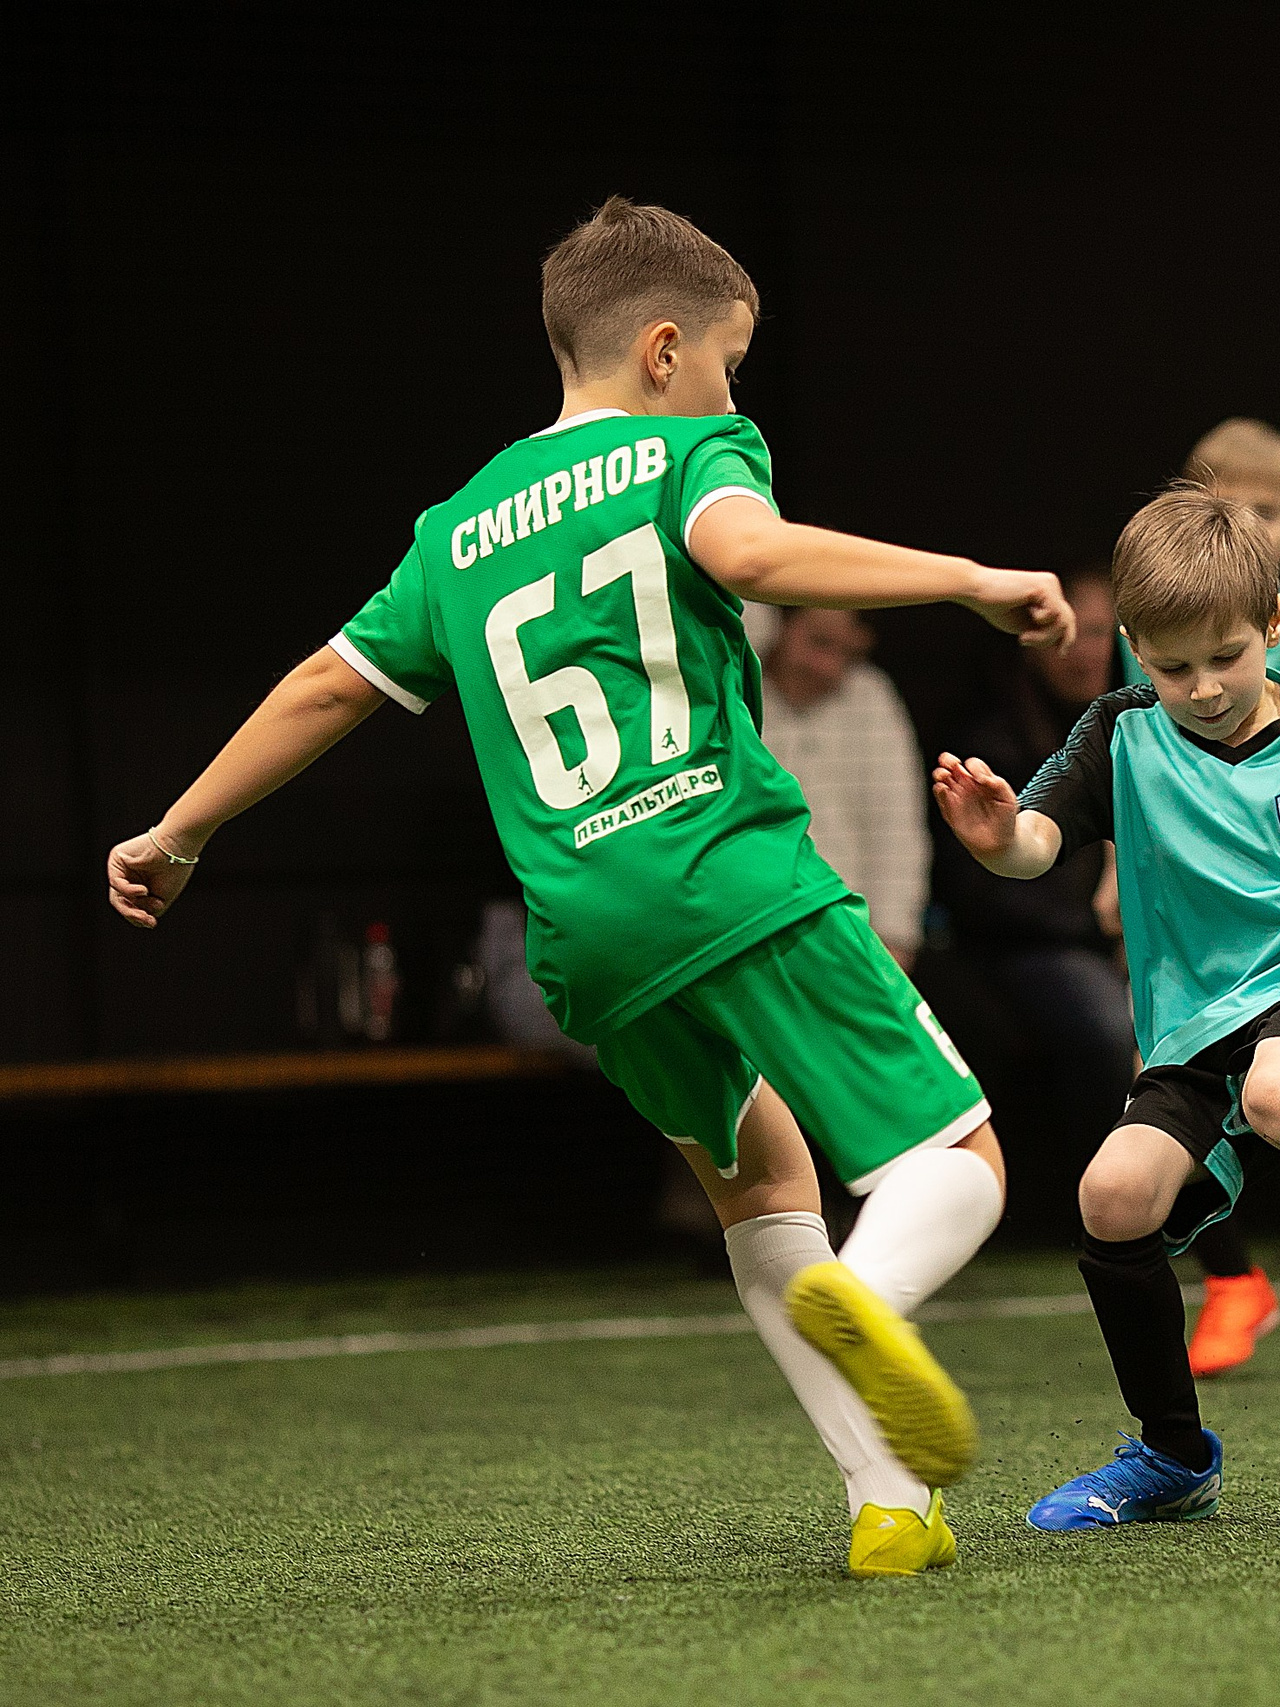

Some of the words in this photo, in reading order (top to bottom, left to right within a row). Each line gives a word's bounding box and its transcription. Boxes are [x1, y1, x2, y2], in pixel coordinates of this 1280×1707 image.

[450, 435, 668, 571] СМИРНОВ
[485, 522, 690, 811] 67
[577, 770, 718, 843] ПЕНАЛЬТИ.РФ
